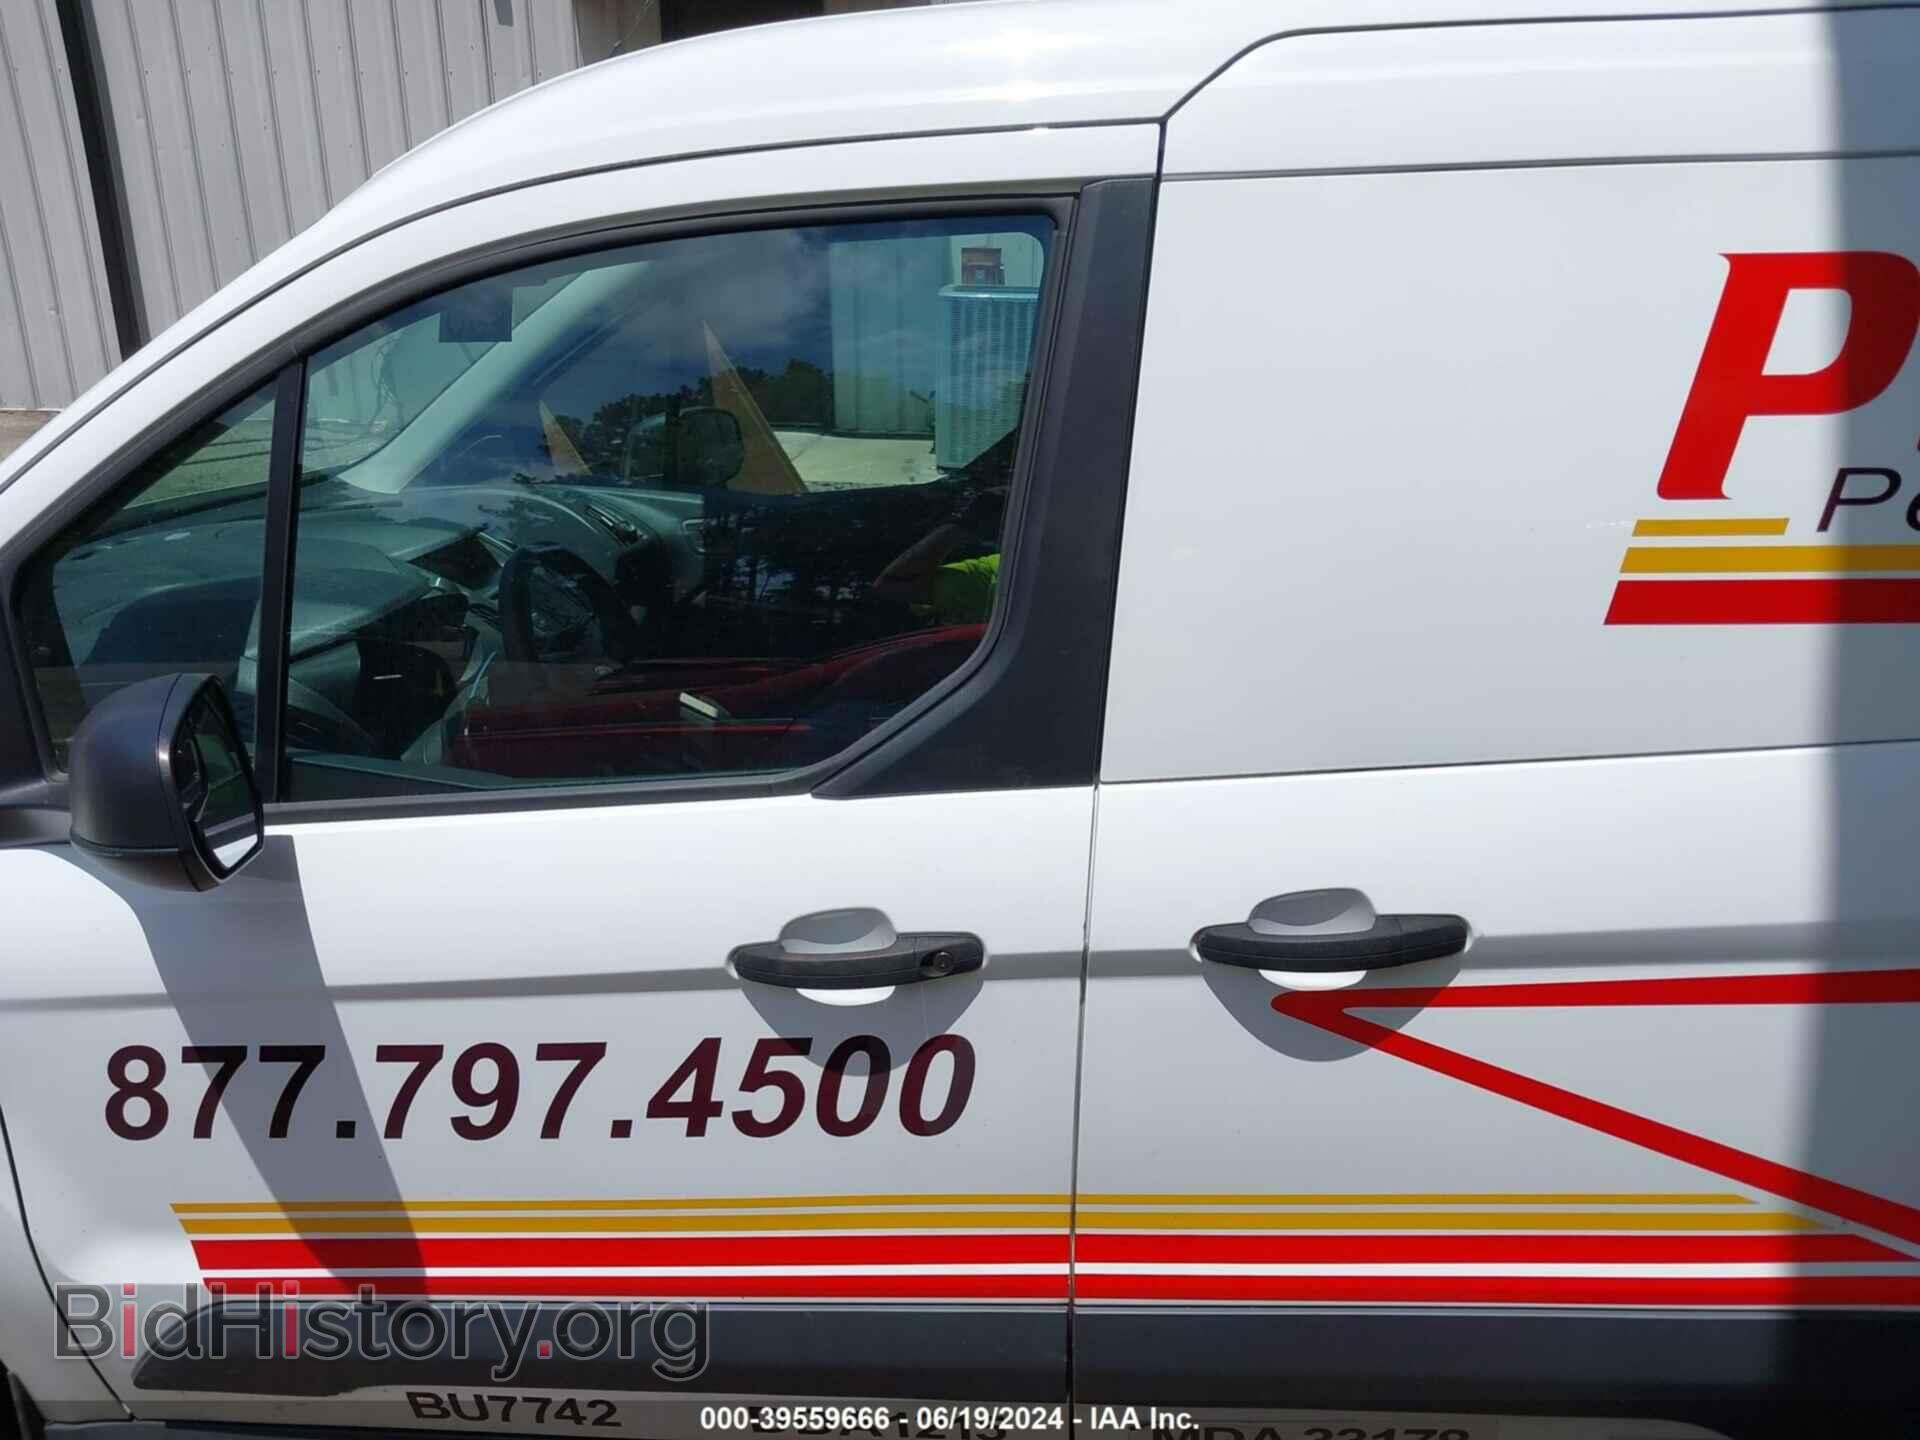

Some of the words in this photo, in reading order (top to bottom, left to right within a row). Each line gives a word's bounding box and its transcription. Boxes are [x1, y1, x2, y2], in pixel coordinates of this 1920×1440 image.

[1657, 251, 1920, 500] P
[1816, 467, 1920, 533] P
[103, 1034, 977, 1140] 877.797.4500
[406, 1391, 623, 1427] BU7742
